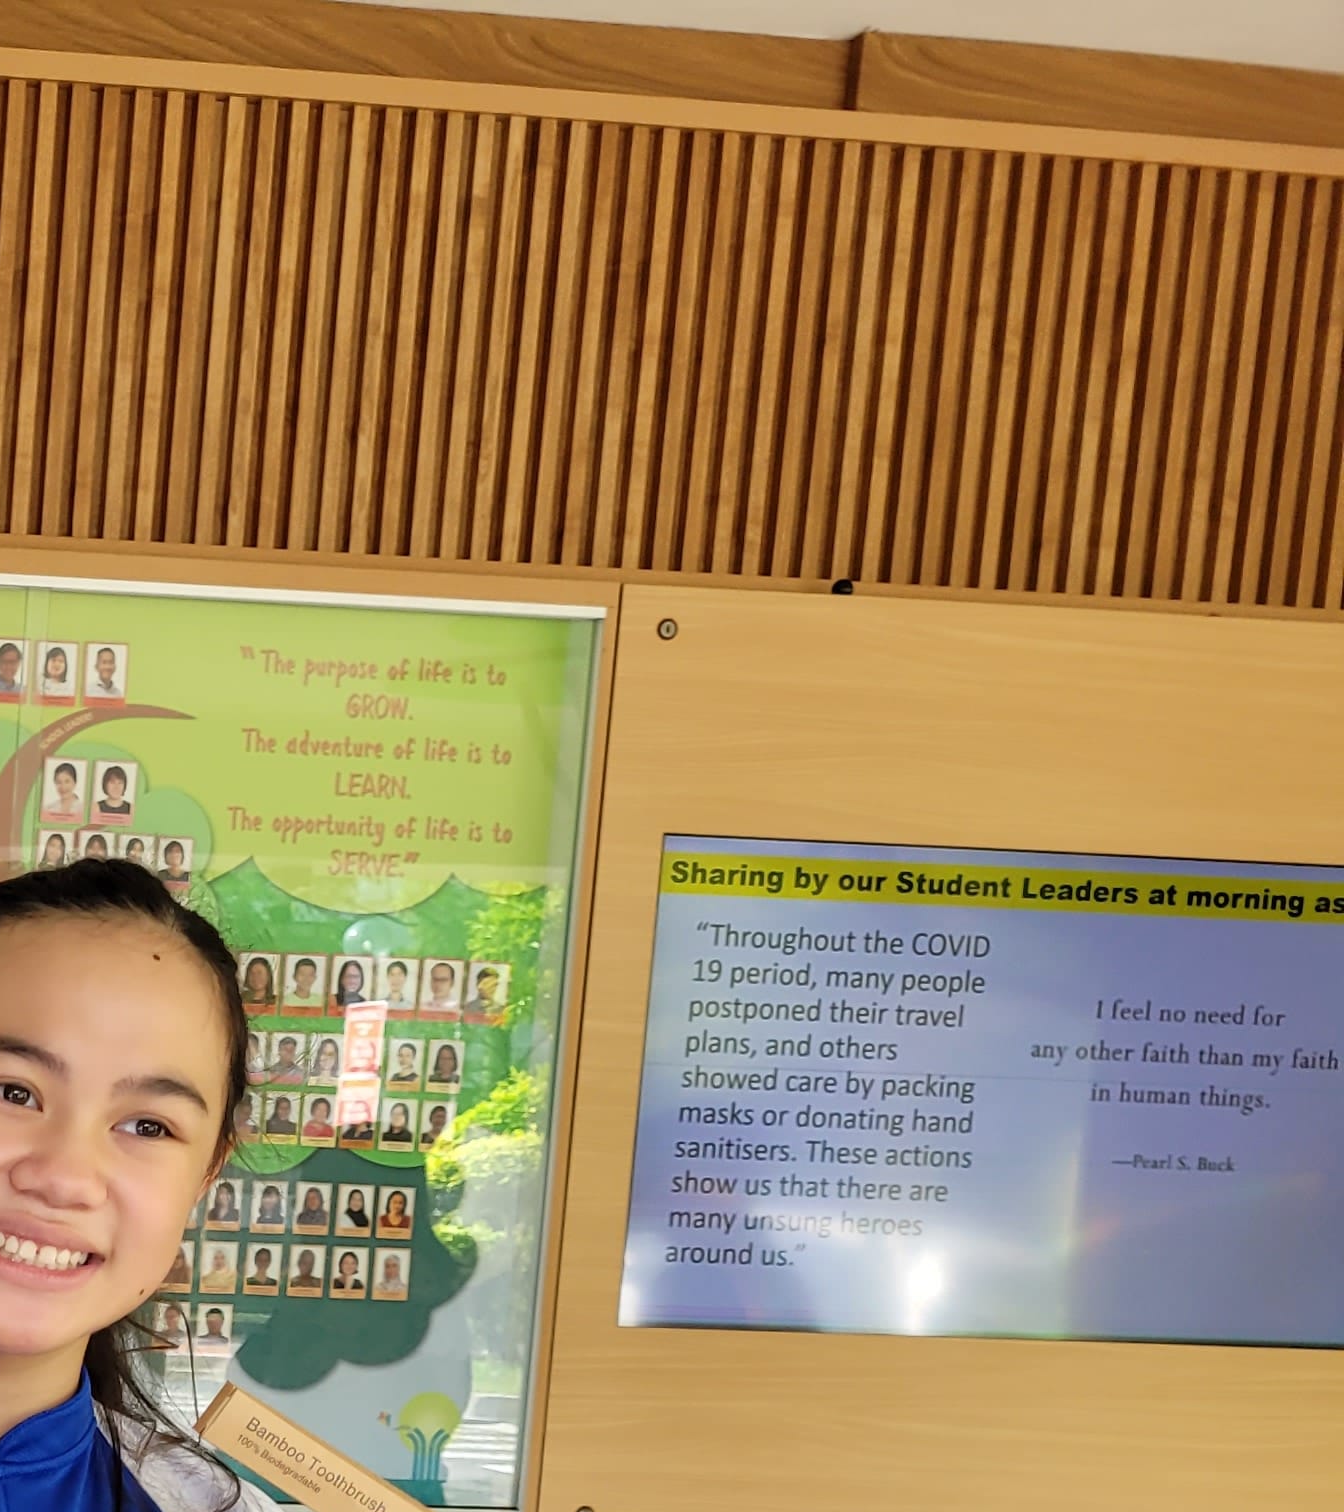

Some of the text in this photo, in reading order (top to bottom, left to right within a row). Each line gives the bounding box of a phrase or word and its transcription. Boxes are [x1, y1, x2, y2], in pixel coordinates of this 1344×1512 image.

[305, 657, 378, 688] purpose
[387, 660, 410, 682] of
[418, 662, 453, 684] life
[462, 662, 477, 685] is
[487, 665, 506, 687] to
[345, 694, 413, 720] GROW.
[241, 729, 511, 767] The adventure of life is to
[334, 772, 412, 800] LEARN.
[227, 807, 513, 848] The opportunity of life is to
[670, 860, 784, 893] Sharing
[794, 866, 830, 896] by
[838, 873, 887, 893] our
[896, 870, 1010, 898] Student
[1022, 877, 1138, 904] Leaders
[1148, 883, 1177, 905] at
[1187, 888, 1305, 918] morning
[697, 920, 991, 959] “Throughout the COVID
[692, 958, 986, 997] 19 period, many people
[688, 996, 964, 1029] postponed their travel
[1096, 1000, 1286, 1027] I feel no need for
[685, 1030, 898, 1062] plans, and others
[1030, 1039, 1339, 1076] any other faith than my faith
[681, 1066, 976, 1104] showed care by packing
[1091, 1082, 1271, 1116] in human things.
[678, 1101, 974, 1136] masks or donating hand
[674, 1136, 973, 1169] sanitisers. These actions
[1177, 1156, 1191, 1171] S.
[1197, 1157, 1235, 1173] Buck
[671, 1171, 949, 1203] show us that there are
[668, 1210, 923, 1238] many unsung heroes
[665, 1242, 753, 1267] around
[246, 1415, 307, 1465] Bamboo
